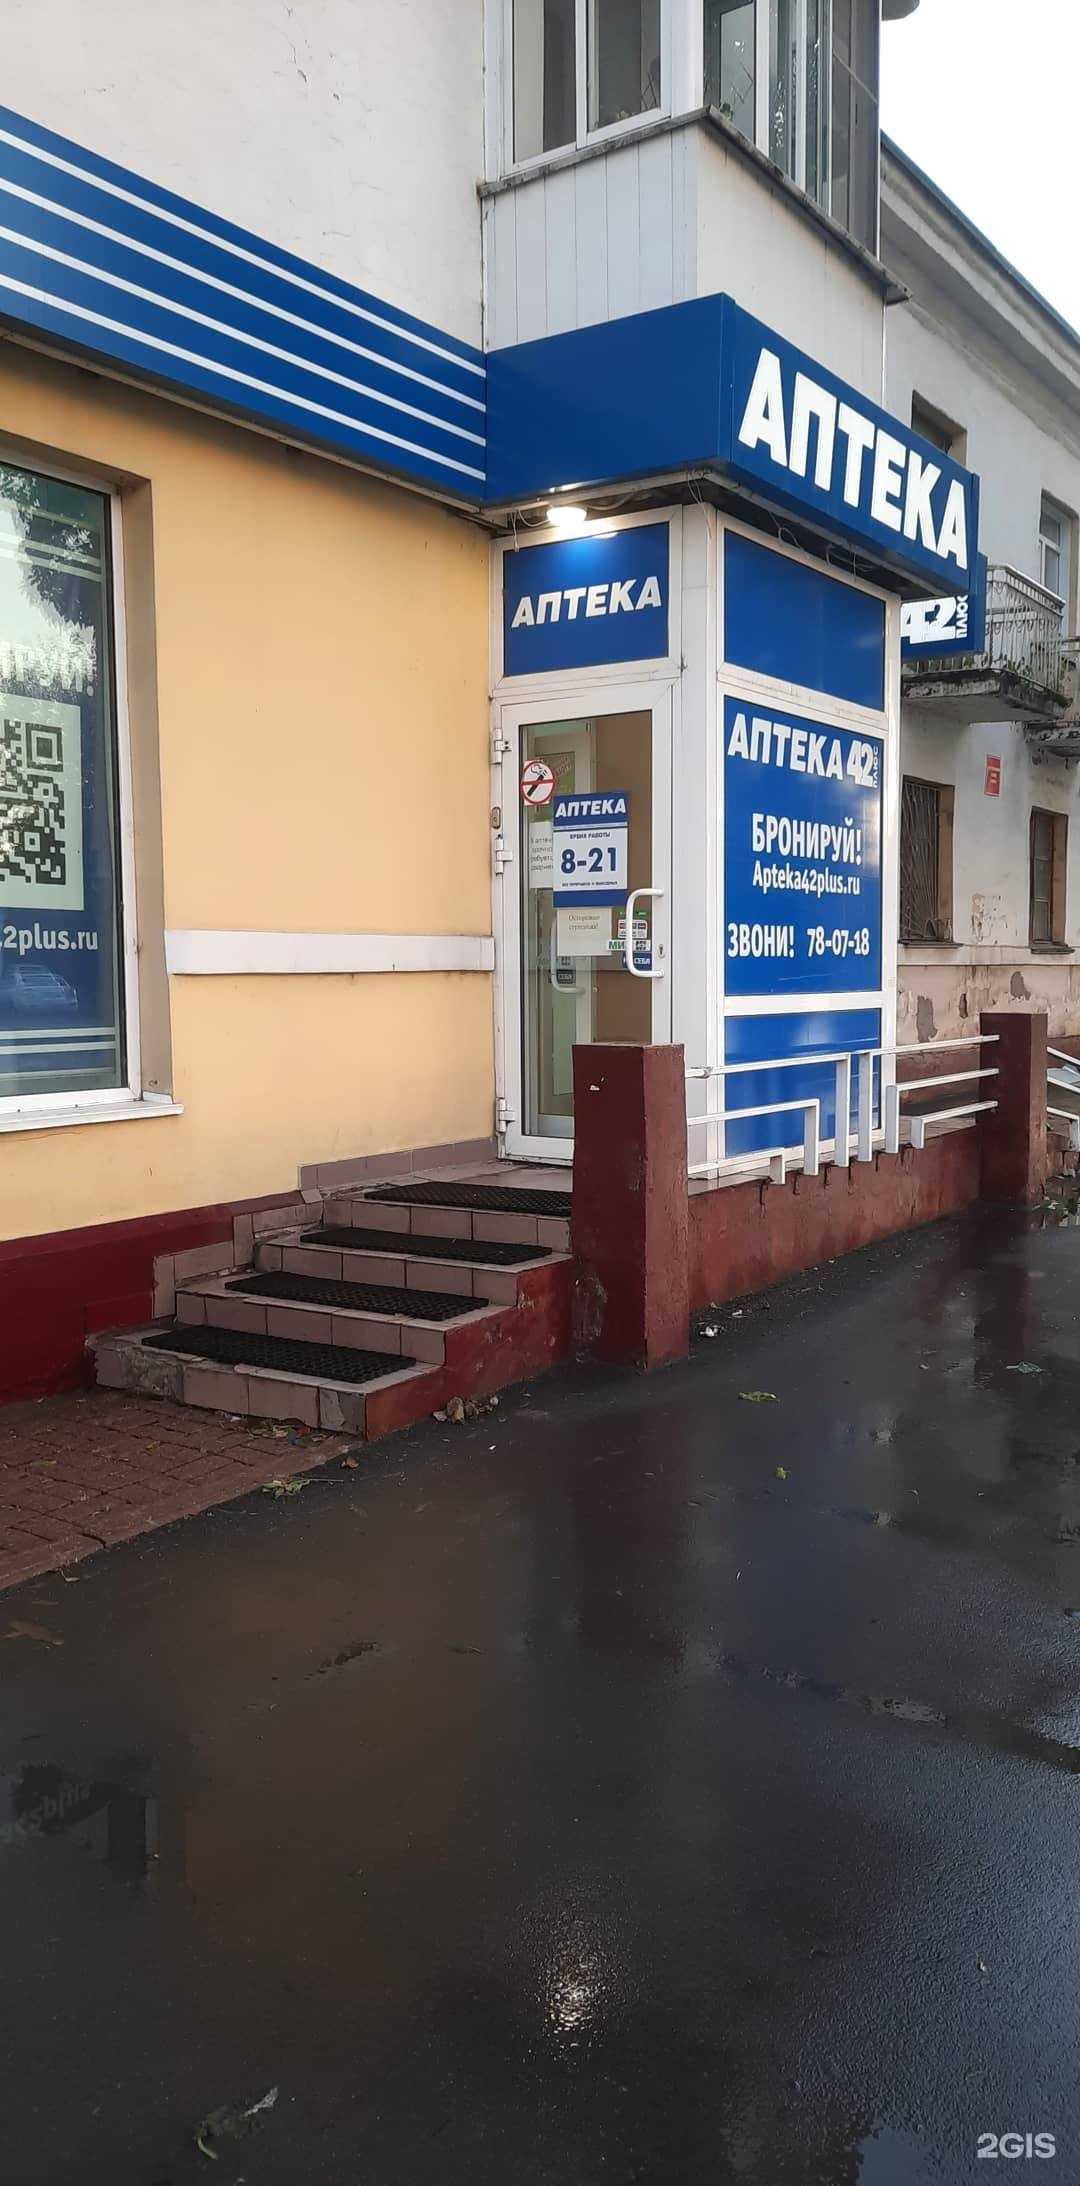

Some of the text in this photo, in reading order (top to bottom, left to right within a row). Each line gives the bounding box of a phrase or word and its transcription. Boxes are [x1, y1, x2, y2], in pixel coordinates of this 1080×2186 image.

[738, 347, 968, 570] АПТЕКА
[511, 576, 662, 629] АПТЕКА
[900, 597, 957, 644] 42
[728, 713, 844, 780] АПТЕКА
[847, 740, 874, 788] 42
[555, 798, 627, 818] АПТЕКА
[752, 813, 862, 865] БРОНИРУЙ!
[561, 847, 617, 874] 8-21
[752, 861, 861, 898] Apteka42plus.ru
[0, 923, 98, 955] 2plus.ru
[608, 941, 625, 950] МИ
[728, 922, 870, 958] ЗВОНИ! 78-07-18
